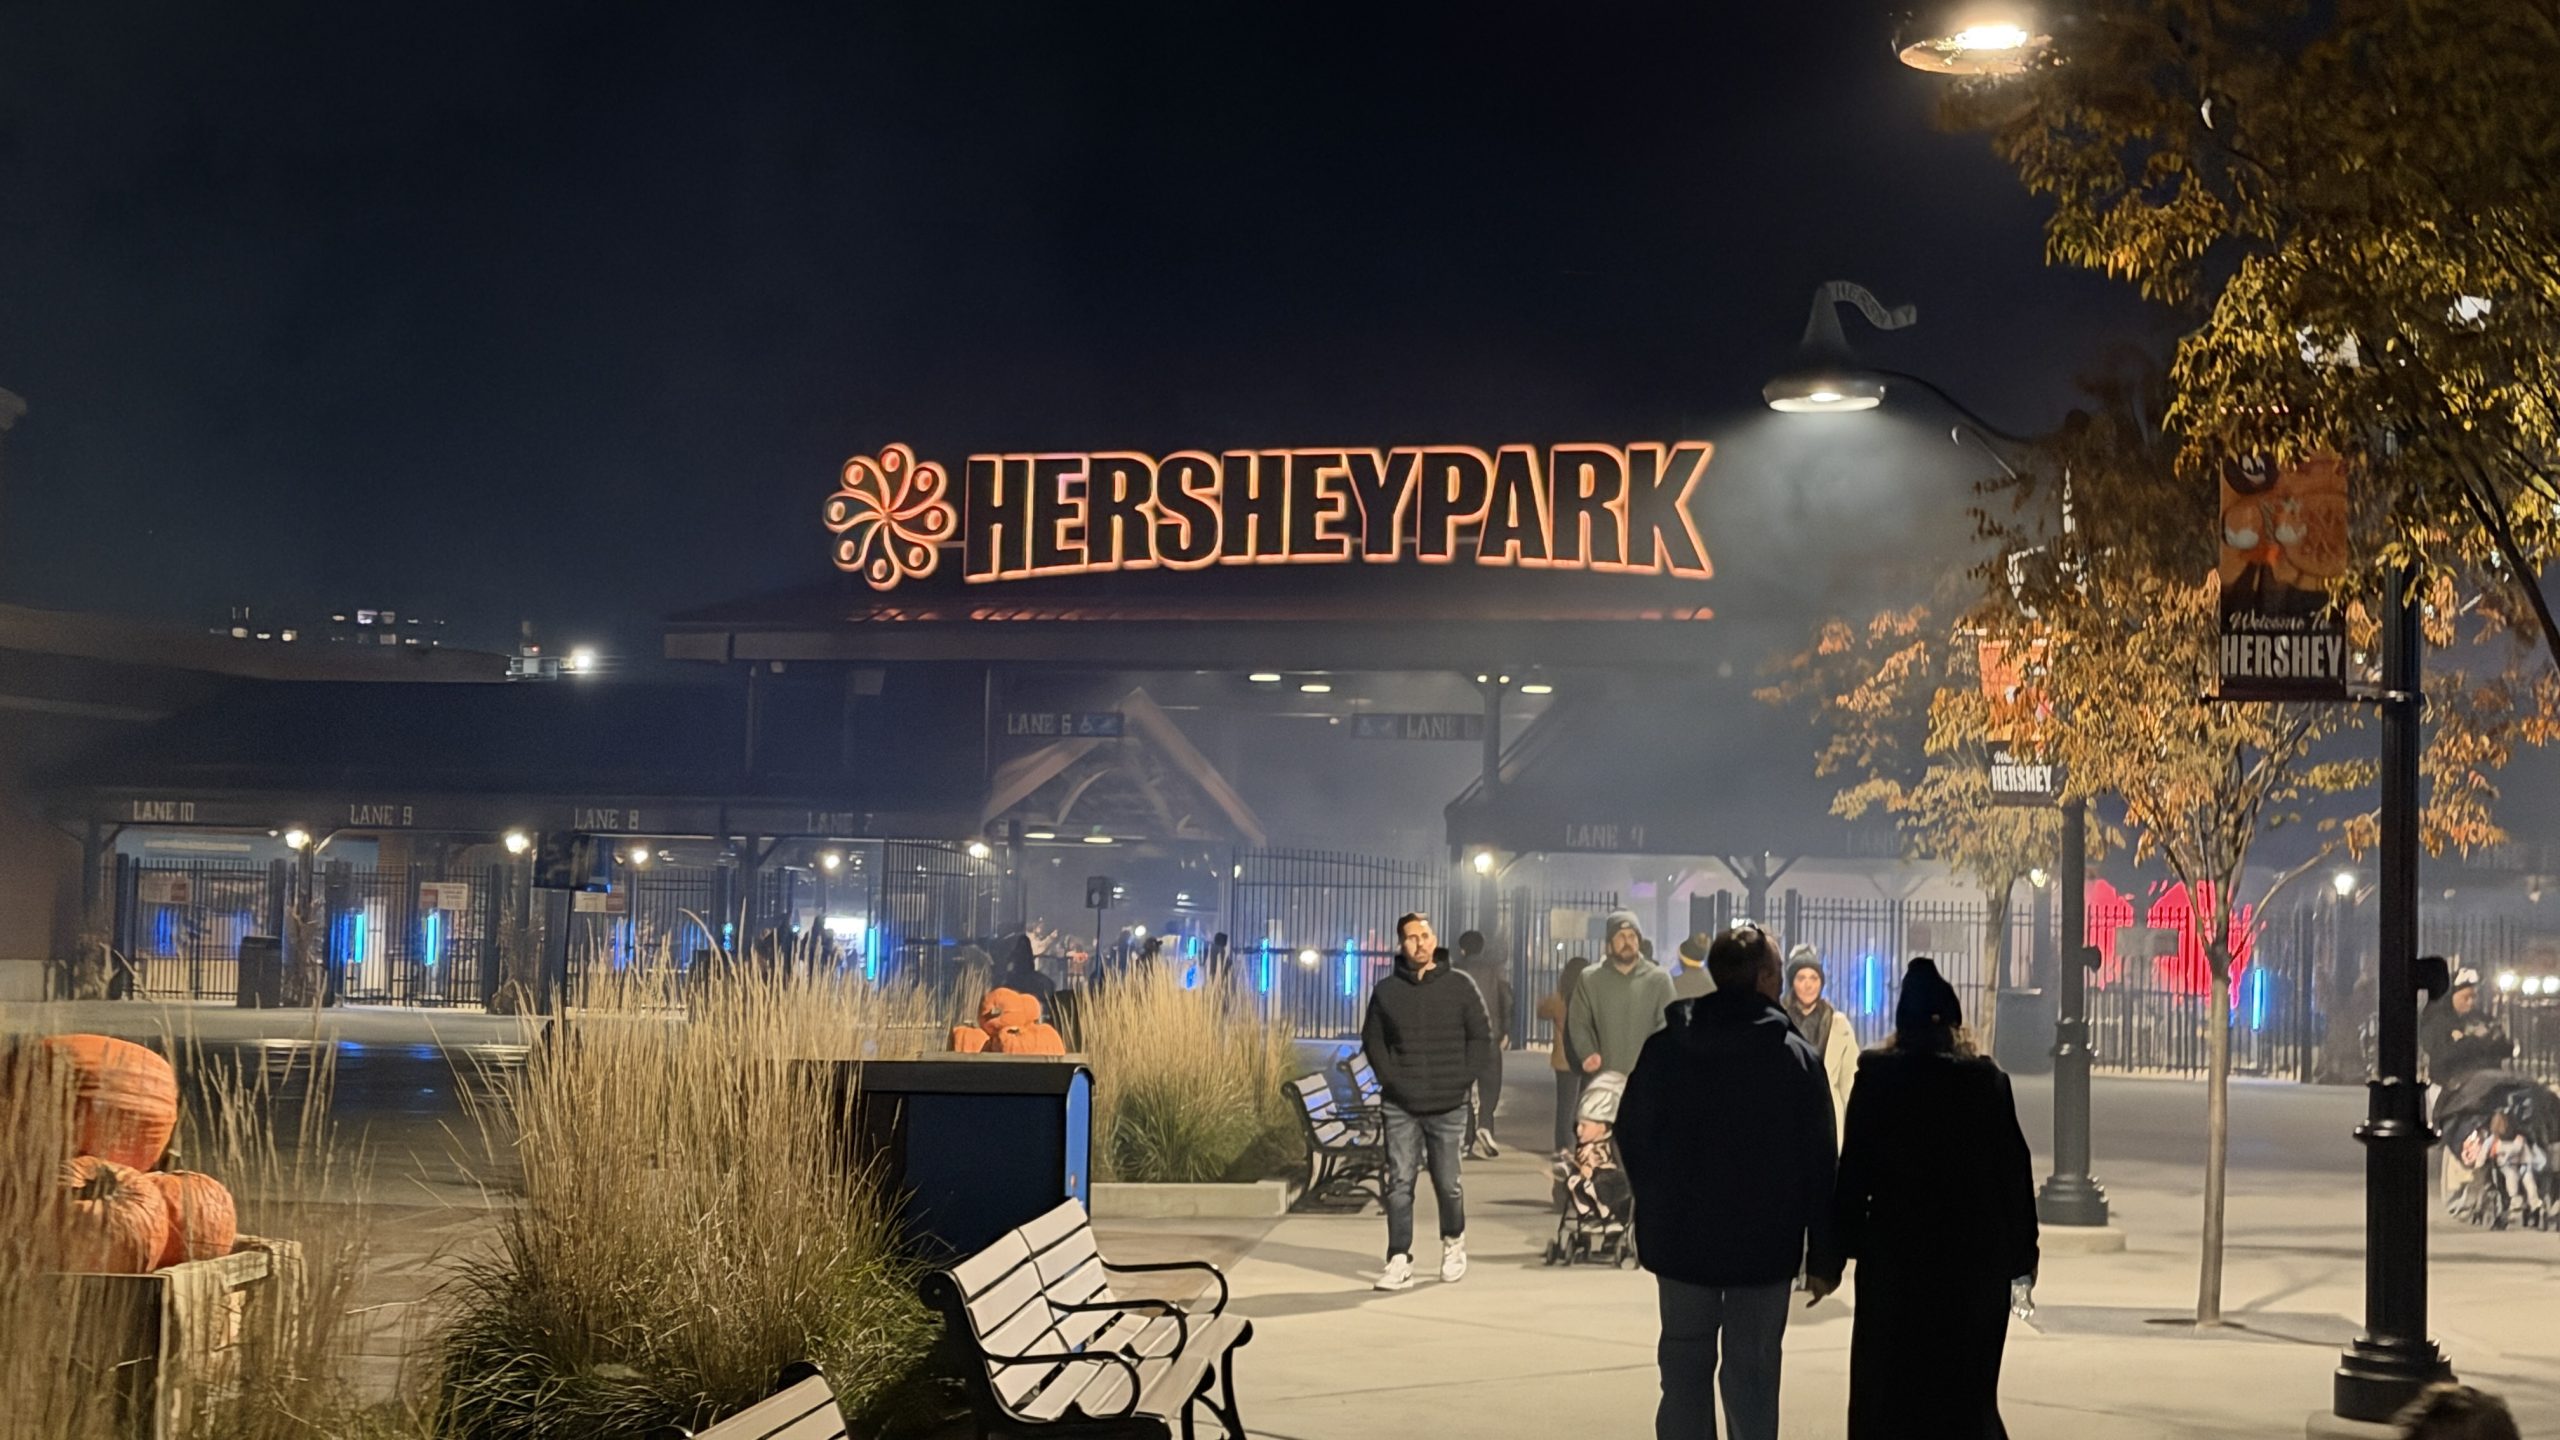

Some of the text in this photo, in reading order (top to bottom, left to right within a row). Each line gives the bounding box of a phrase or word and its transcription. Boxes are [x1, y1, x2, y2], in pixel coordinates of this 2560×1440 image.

[963, 441, 1716, 583] HERSHEYPARK
[2229, 608, 2305, 631] Welcome
[2221, 634, 2342, 678] HERSHEY
[1007, 712, 1055, 735] LANE
[1406, 715, 1457, 738] LANE
[1991, 765, 2052, 792] HERSHEY
[133, 800, 194, 822] LANE 10
[350, 803, 393, 826] LANE
[573, 808, 618, 830] LANE
[1566, 823, 1618, 849] LANE
